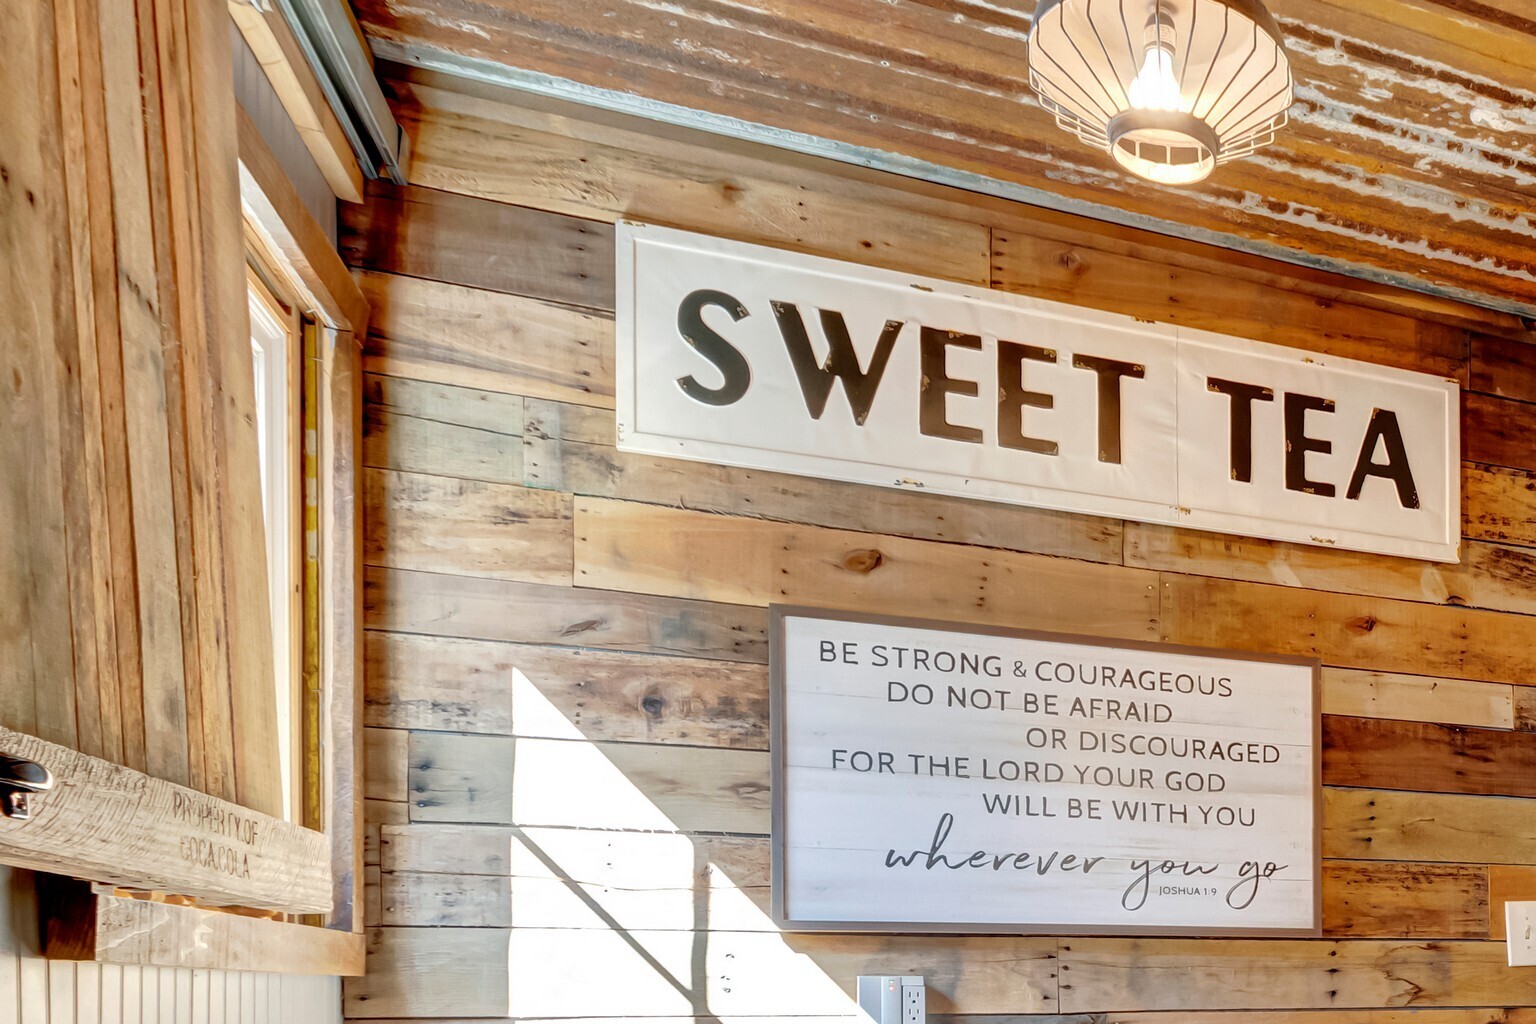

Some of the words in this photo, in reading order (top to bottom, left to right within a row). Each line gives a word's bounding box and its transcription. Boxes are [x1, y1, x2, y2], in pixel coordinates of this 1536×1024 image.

[675, 288, 1146, 466] SWEET
[1206, 376, 1421, 511] TEA
[819, 640, 859, 666] BE
[871, 645, 1002, 678] STRONG
[1012, 660, 1028, 678] &
[1034, 660, 1233, 698] COURAGEOUS
[887, 681, 934, 706] DO
[947, 685, 1012, 712] NOT
[1023, 692, 1059, 716] BE
[1069, 696, 1173, 724] AFRAID
[1025, 727, 1068, 751] OR
[1079, 730, 1280, 764] DISCOURAGED
[831, 748, 896, 775] FOR
[907, 753, 971, 780] THE
[982, 758, 1064, 784] LORD
[1073, 764, 1155, 790] YOUR
[1164, 770, 1226, 793] GOD
[981, 793, 1057, 818] WILL
[1067, 798, 1102, 821] BE
[1111, 800, 1188, 825] WITH
[1197, 805, 1255, 827] YOU
[884, 812, 1107, 876] wherever
[1121, 857, 1219, 912] you
[1225, 859, 1289, 911] go
[1158, 885, 1201, 896] JOSHUA
[1202, 887, 1218, 896] 1:9
